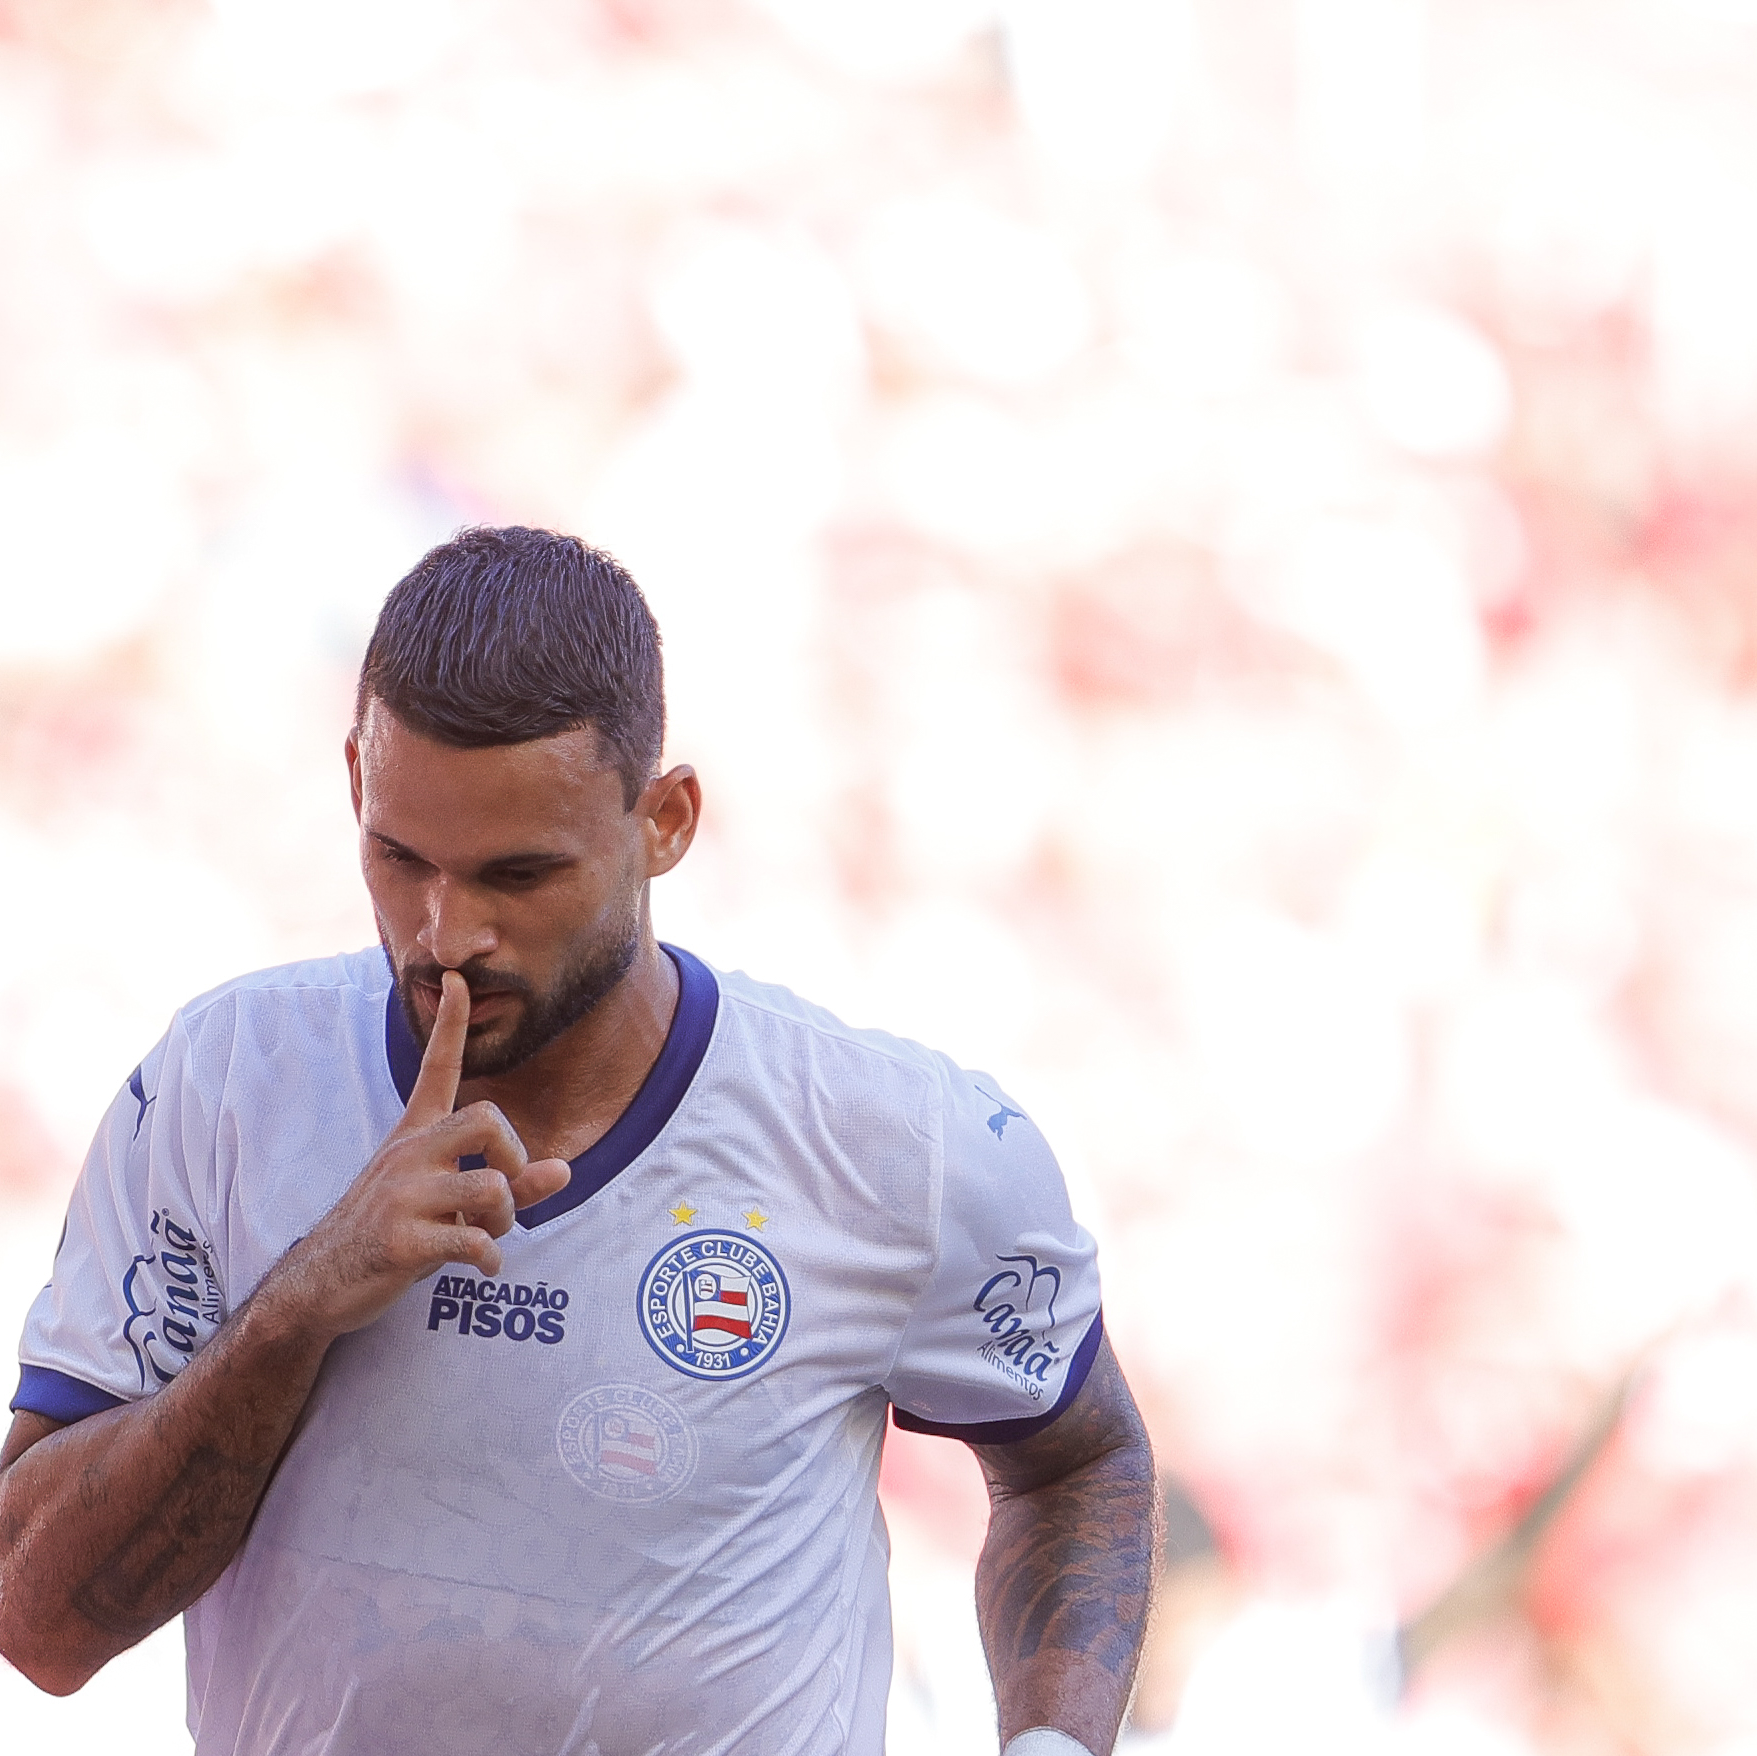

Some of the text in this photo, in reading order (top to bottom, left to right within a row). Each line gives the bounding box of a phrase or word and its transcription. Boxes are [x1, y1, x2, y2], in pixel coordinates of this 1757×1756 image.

[432, 1275, 570, 1311] ATACADÃO
[650, 1241, 780, 1346] ESPORTE CLUBE BAHIA
[428, 1297, 566, 1345] PISOS
[973, 1270, 1060, 1382] Canaã
[695, 1351, 732, 1369] 1931
[976, 1340, 1044, 1401] Alimentos
